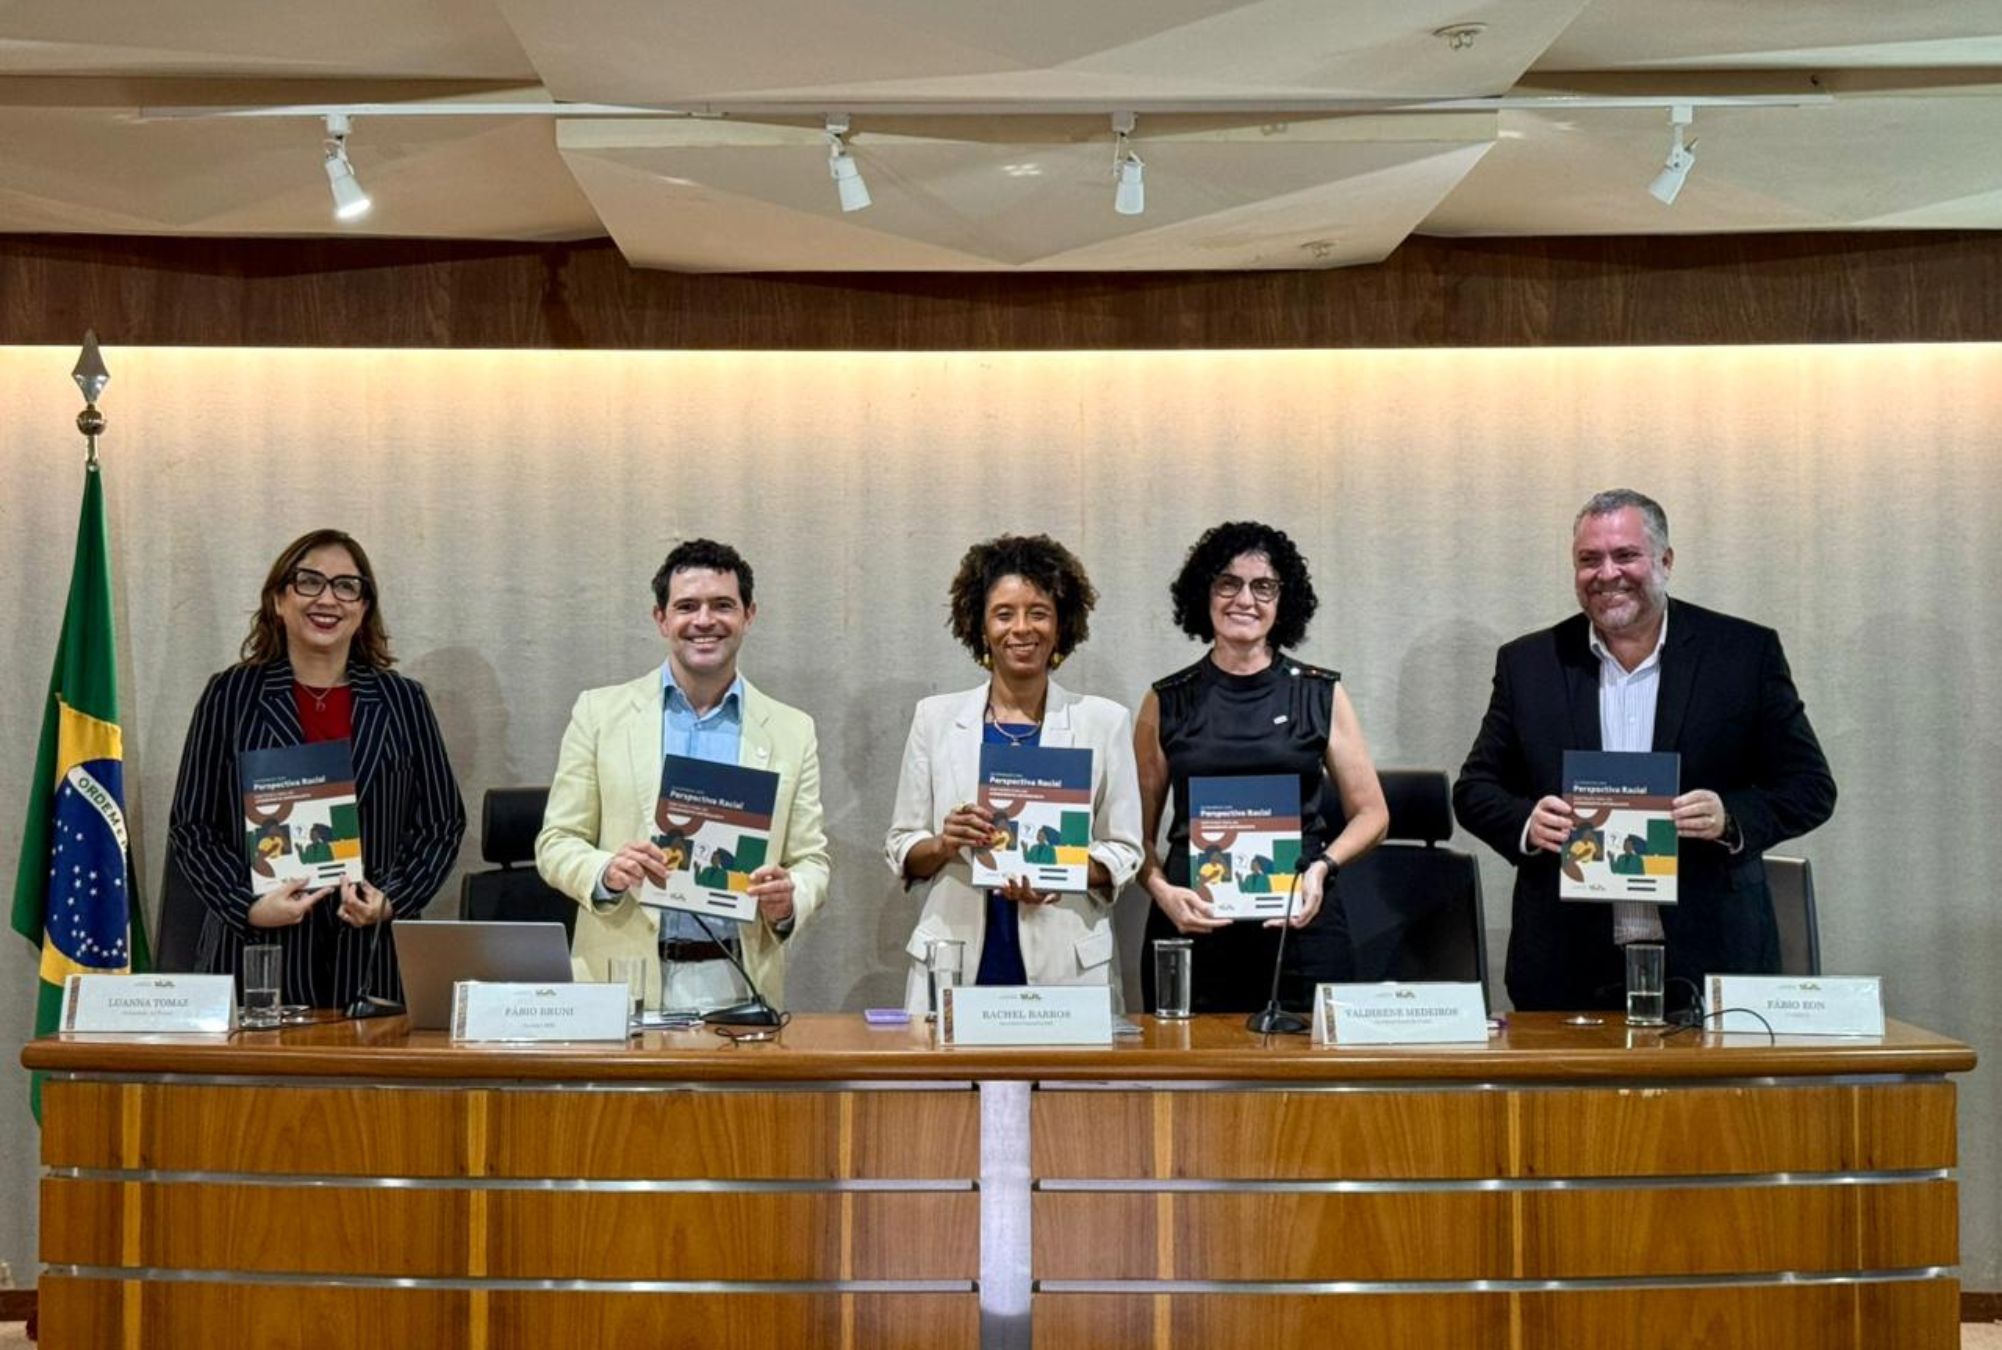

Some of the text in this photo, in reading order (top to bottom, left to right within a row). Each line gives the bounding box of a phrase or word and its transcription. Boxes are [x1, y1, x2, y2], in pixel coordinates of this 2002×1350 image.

[302, 775, 326, 784] Racial
[989, 776, 1062, 788] Perspectiva Racial
[1573, 785, 1647, 795] Perspectiva Racial
[79, 777, 120, 826] ORDEM
[669, 790, 717, 806] Perspectiva
[717, 799, 745, 811] Racial
[1247, 808, 1272, 817] Racial
[108, 998, 152, 1008] LUANNA
[505, 1005, 574, 1016] FÁBIO BRUNI
[982, 1010, 1071, 1020] RACHEL BARROS
